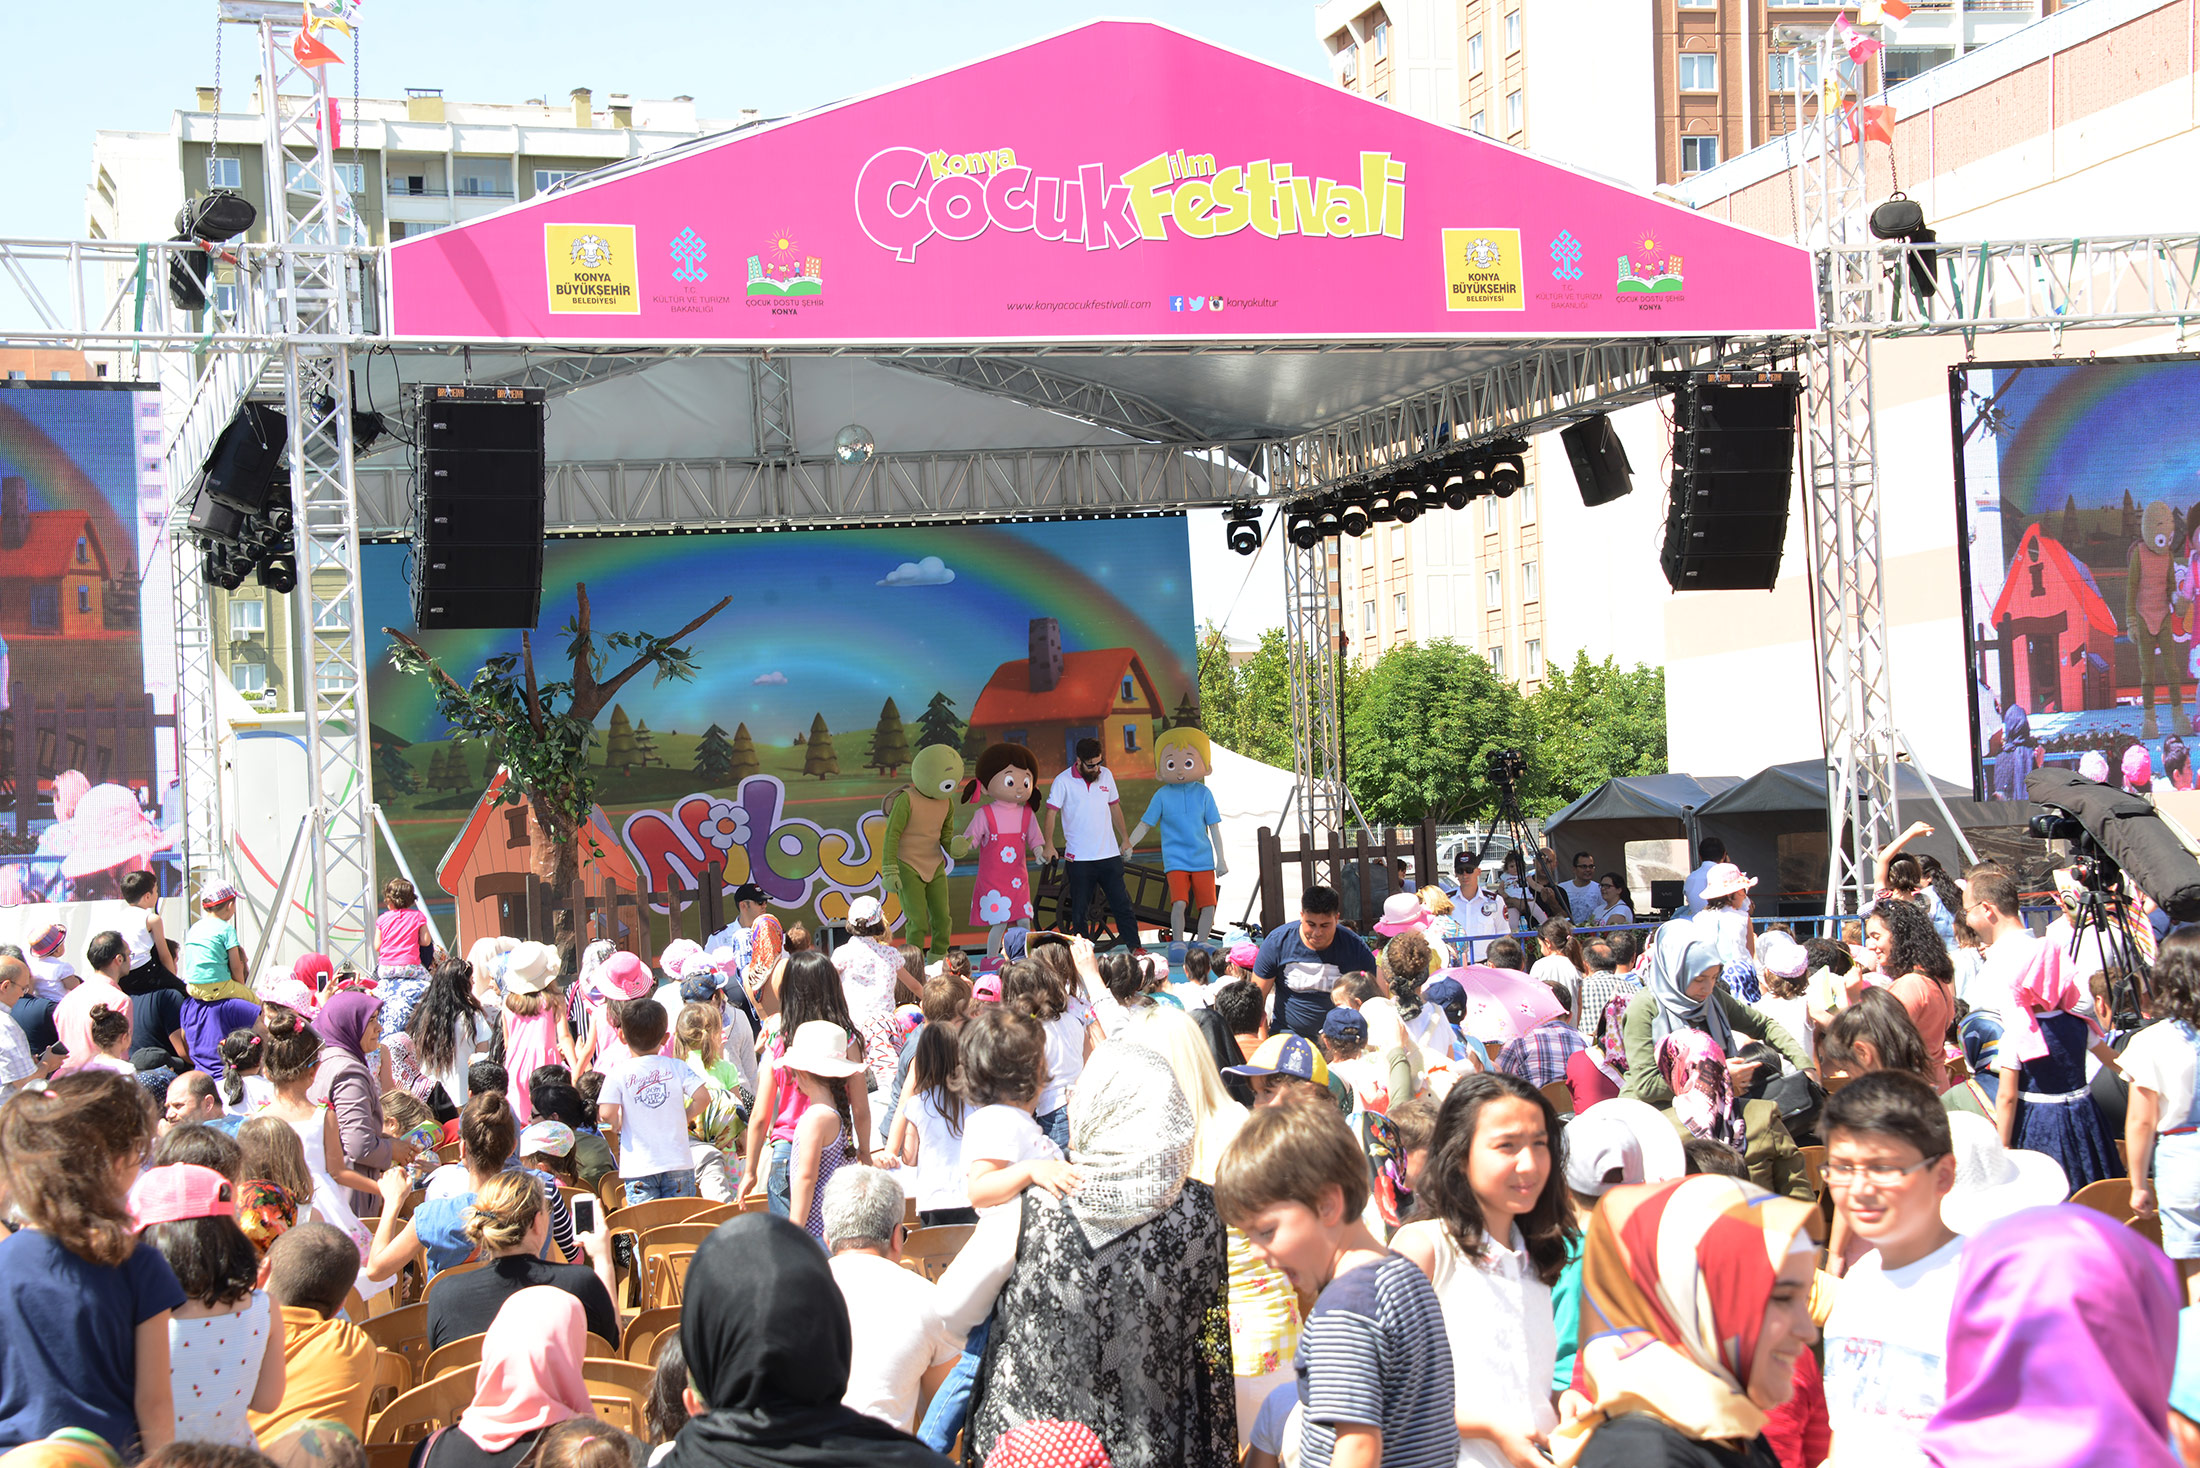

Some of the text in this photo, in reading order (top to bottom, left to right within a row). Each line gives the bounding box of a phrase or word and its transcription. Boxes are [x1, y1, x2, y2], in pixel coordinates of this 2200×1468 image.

[927, 147, 1016, 181] Konya
[1120, 151, 1406, 241] Festivali
[855, 146, 1141, 263] Çocuk
[574, 273, 611, 282] KONYA
[1468, 273, 1500, 281] KONYA
[556, 282, 631, 297] BÜYÜKŞEHİR
[1452, 282, 1516, 295] BÜYÜKŞEHİR
[686, 296, 697, 304] VE
[745, 299, 771, 307] ÇOCUK
[801, 298, 824, 307] ŞEHİR
[1006, 299, 1152, 312] www.konyacocukfestivali.com
[1226, 297, 1278, 310] konyakultur
[1615, 295, 1639, 303] ÇOCUK
[1640, 295, 1663, 303] DOSTU
